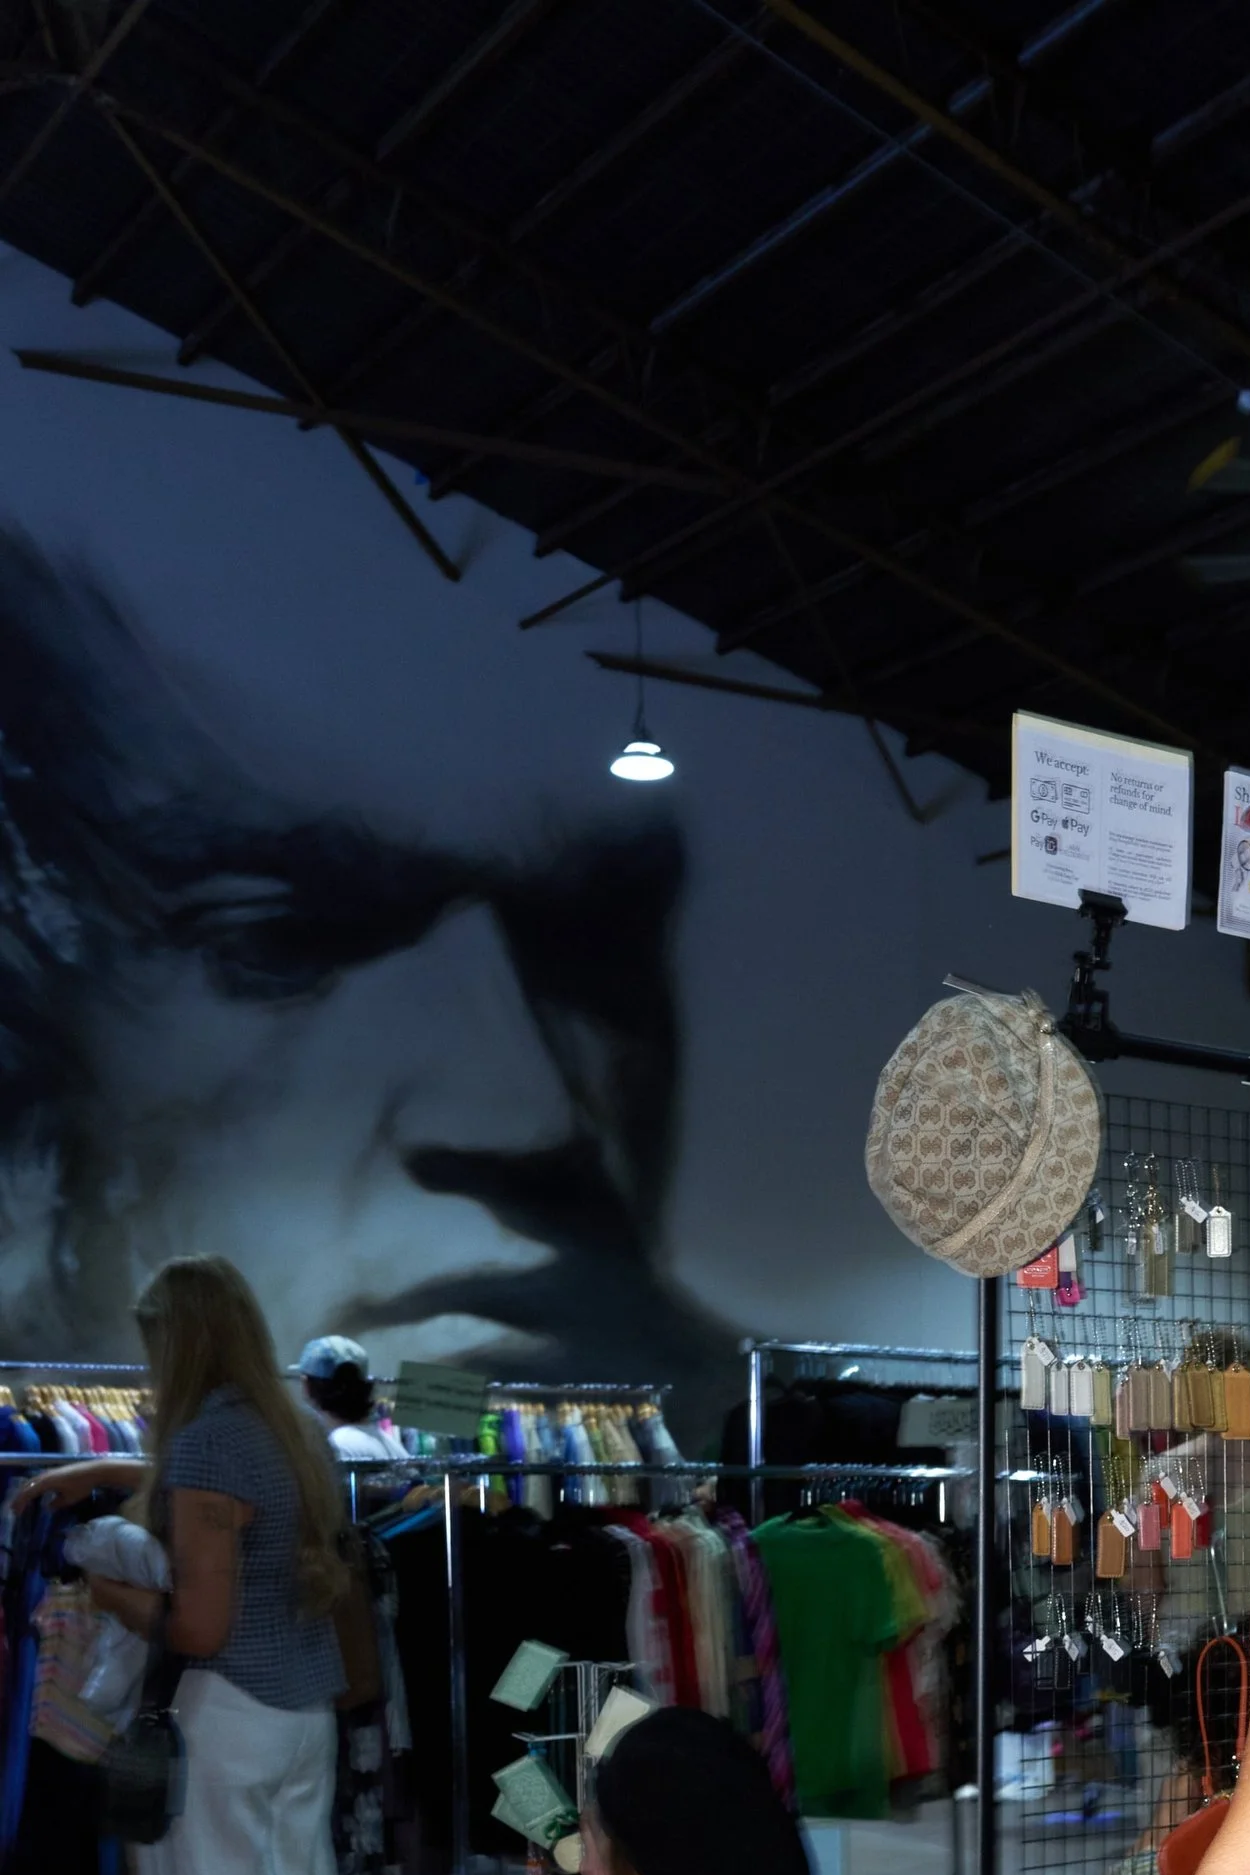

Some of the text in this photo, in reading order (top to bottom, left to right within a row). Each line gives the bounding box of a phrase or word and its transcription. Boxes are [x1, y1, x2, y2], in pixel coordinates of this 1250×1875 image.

[1034, 750, 1090, 777] We accept:
[1110, 772, 1164, 792] No returns or
[1110, 785, 1155, 802] refunds for
[1109, 796, 1173, 817] change of mind.
[1071, 816, 1090, 838] Pay
